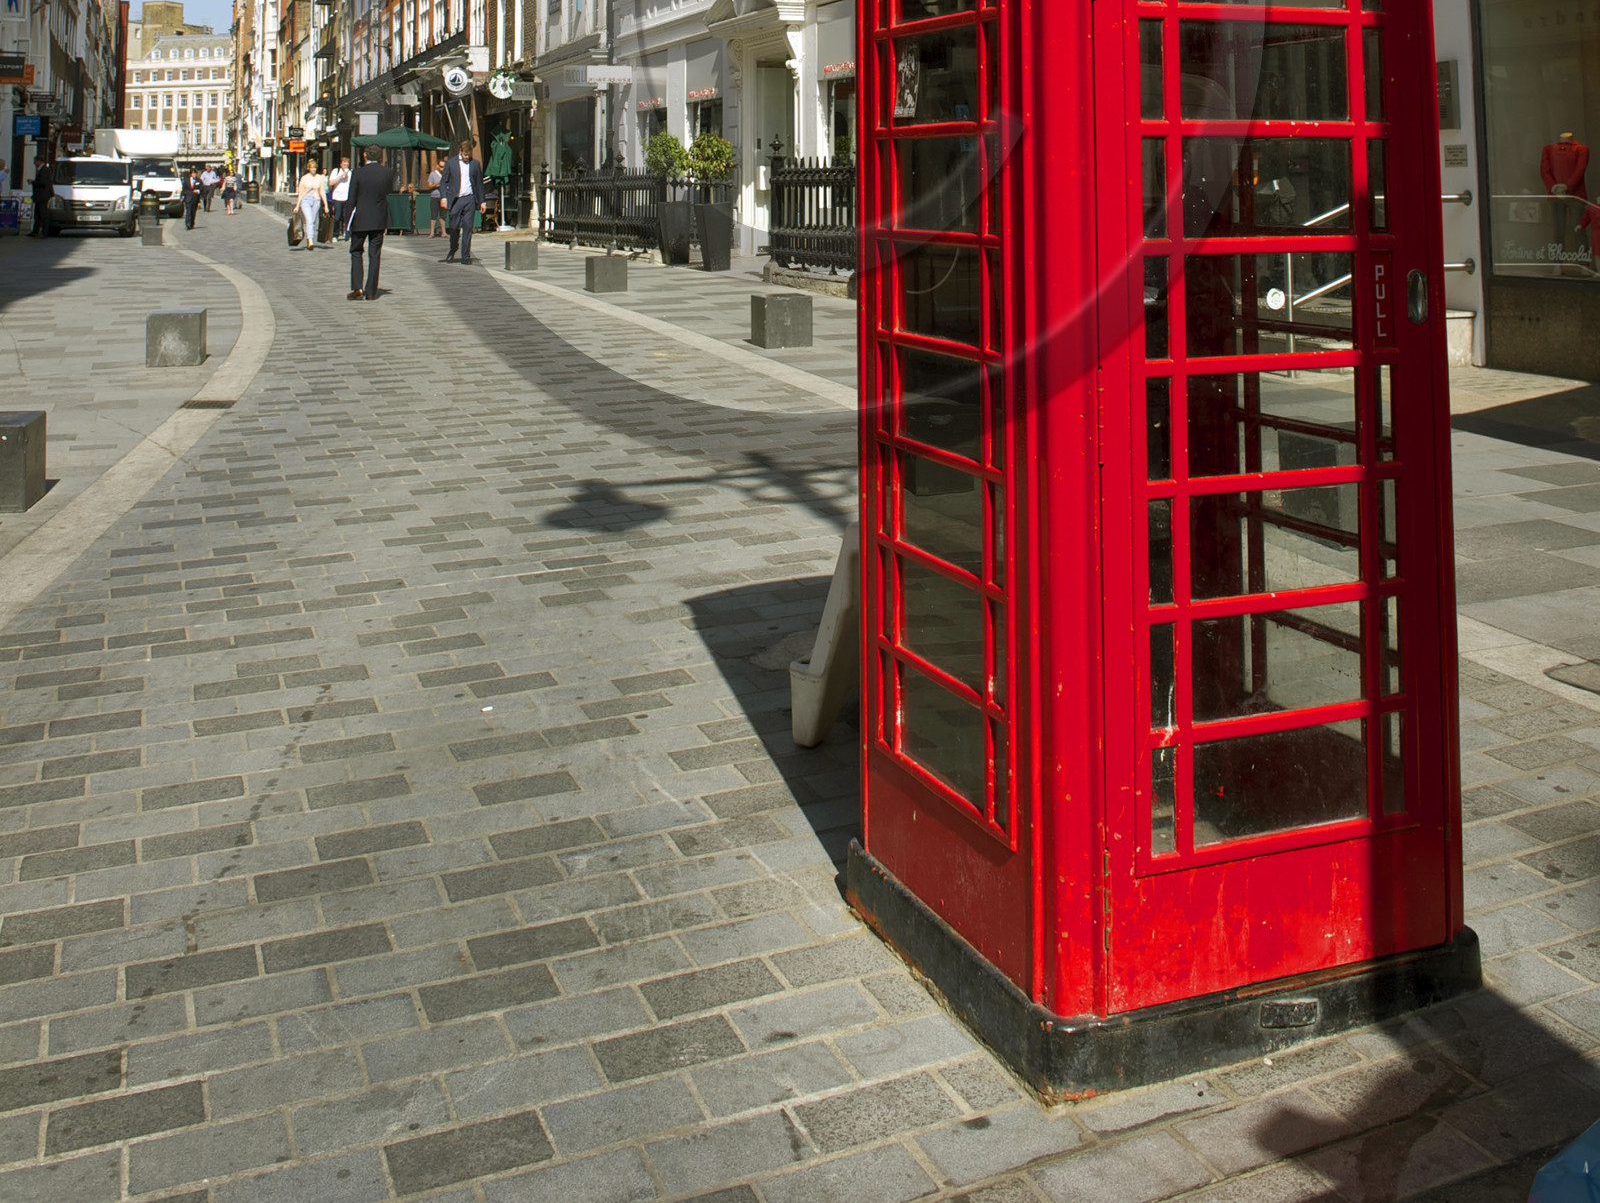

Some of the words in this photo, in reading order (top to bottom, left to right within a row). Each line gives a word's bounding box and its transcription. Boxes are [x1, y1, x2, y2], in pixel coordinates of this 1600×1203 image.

[1535, 245, 1545, 260] et
[1547, 242, 1592, 262] Chocolat
[1374, 264, 1387, 337] PULL
